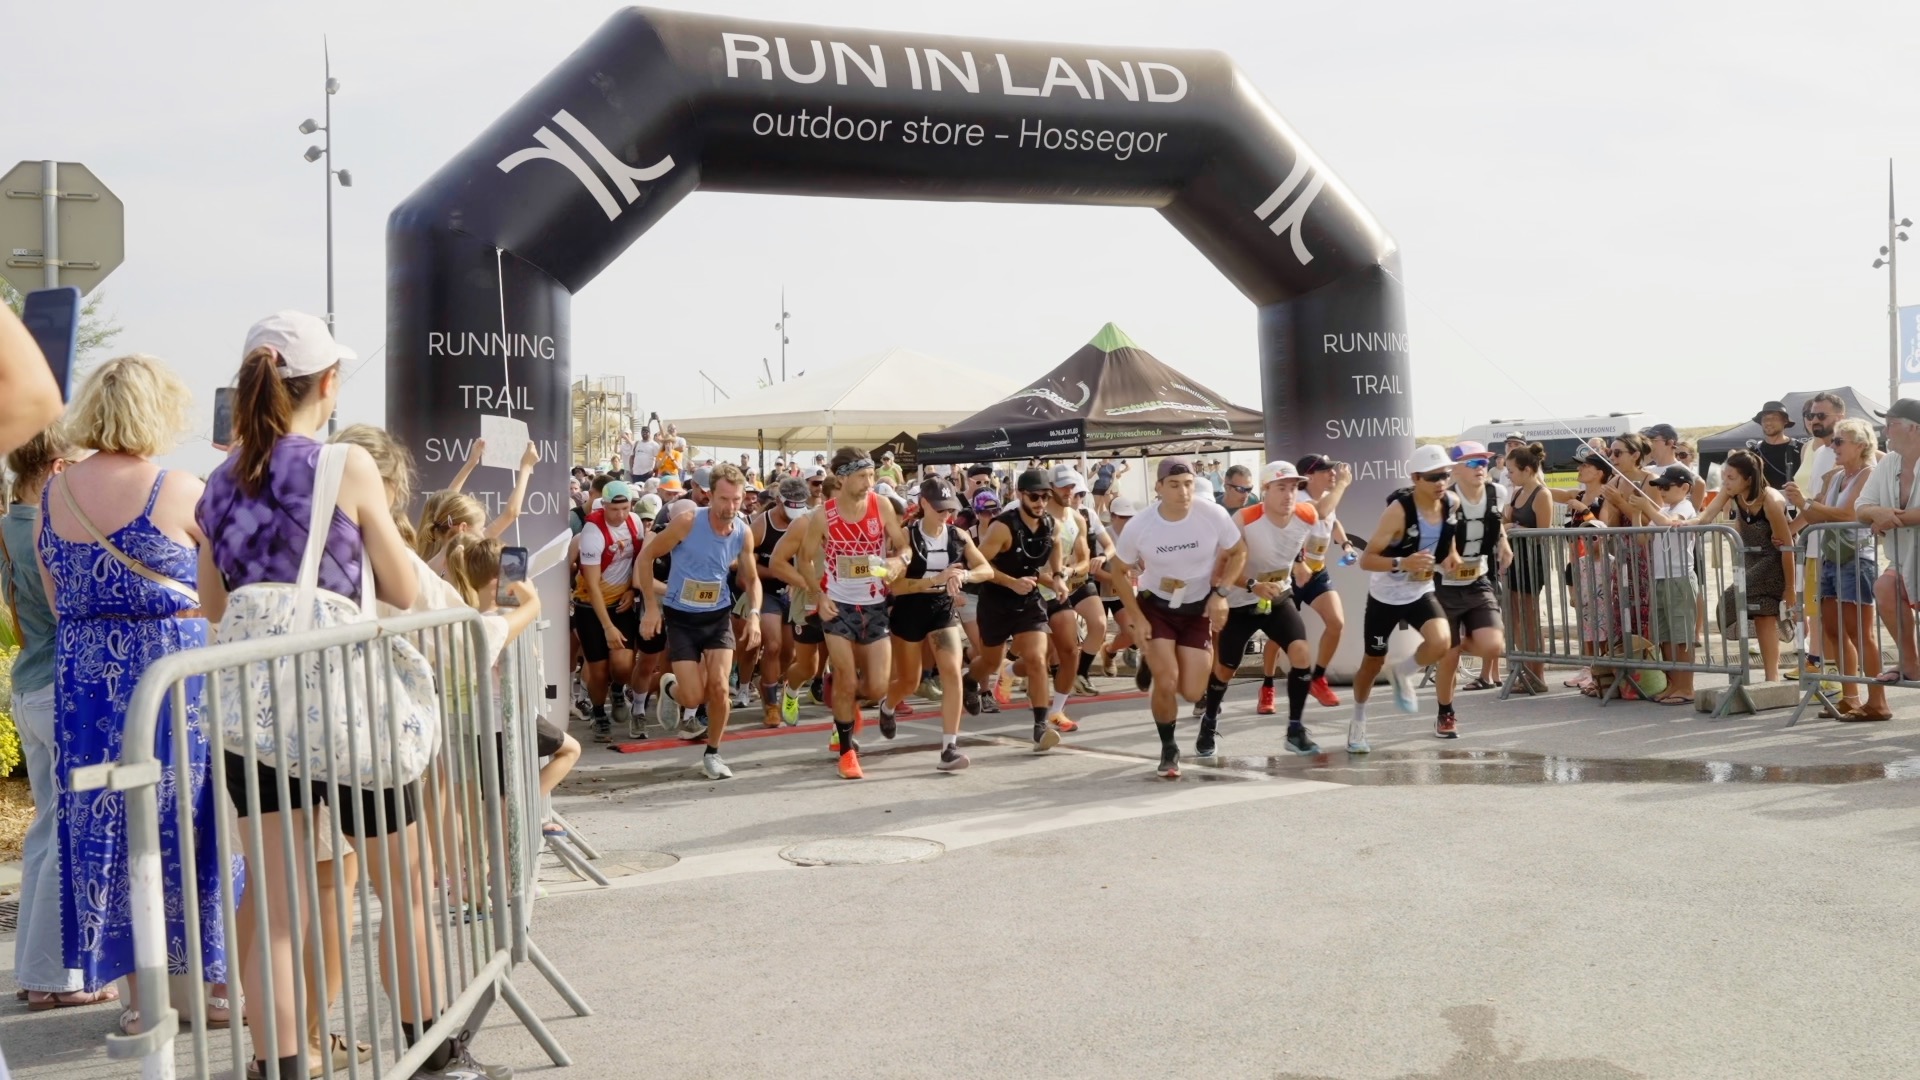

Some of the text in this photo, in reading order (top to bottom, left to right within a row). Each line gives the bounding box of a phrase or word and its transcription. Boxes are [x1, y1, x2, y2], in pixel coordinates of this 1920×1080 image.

[721, 32, 1188, 103] RUN IN LAND
[752, 105, 893, 141] outdoor
[902, 115, 985, 147] store
[1018, 118, 1168, 161] Hossegor
[428, 331, 555, 360] RUNNING
[1323, 332, 1409, 353] RUNNING
[1351, 374, 1403, 395] TRAIL
[458, 385, 534, 411] TRAIL
[1526, 429, 1553, 437] PREMIERS
[1583, 425, 1616, 434] PERSONNES
[700, 591, 713, 599] 878
